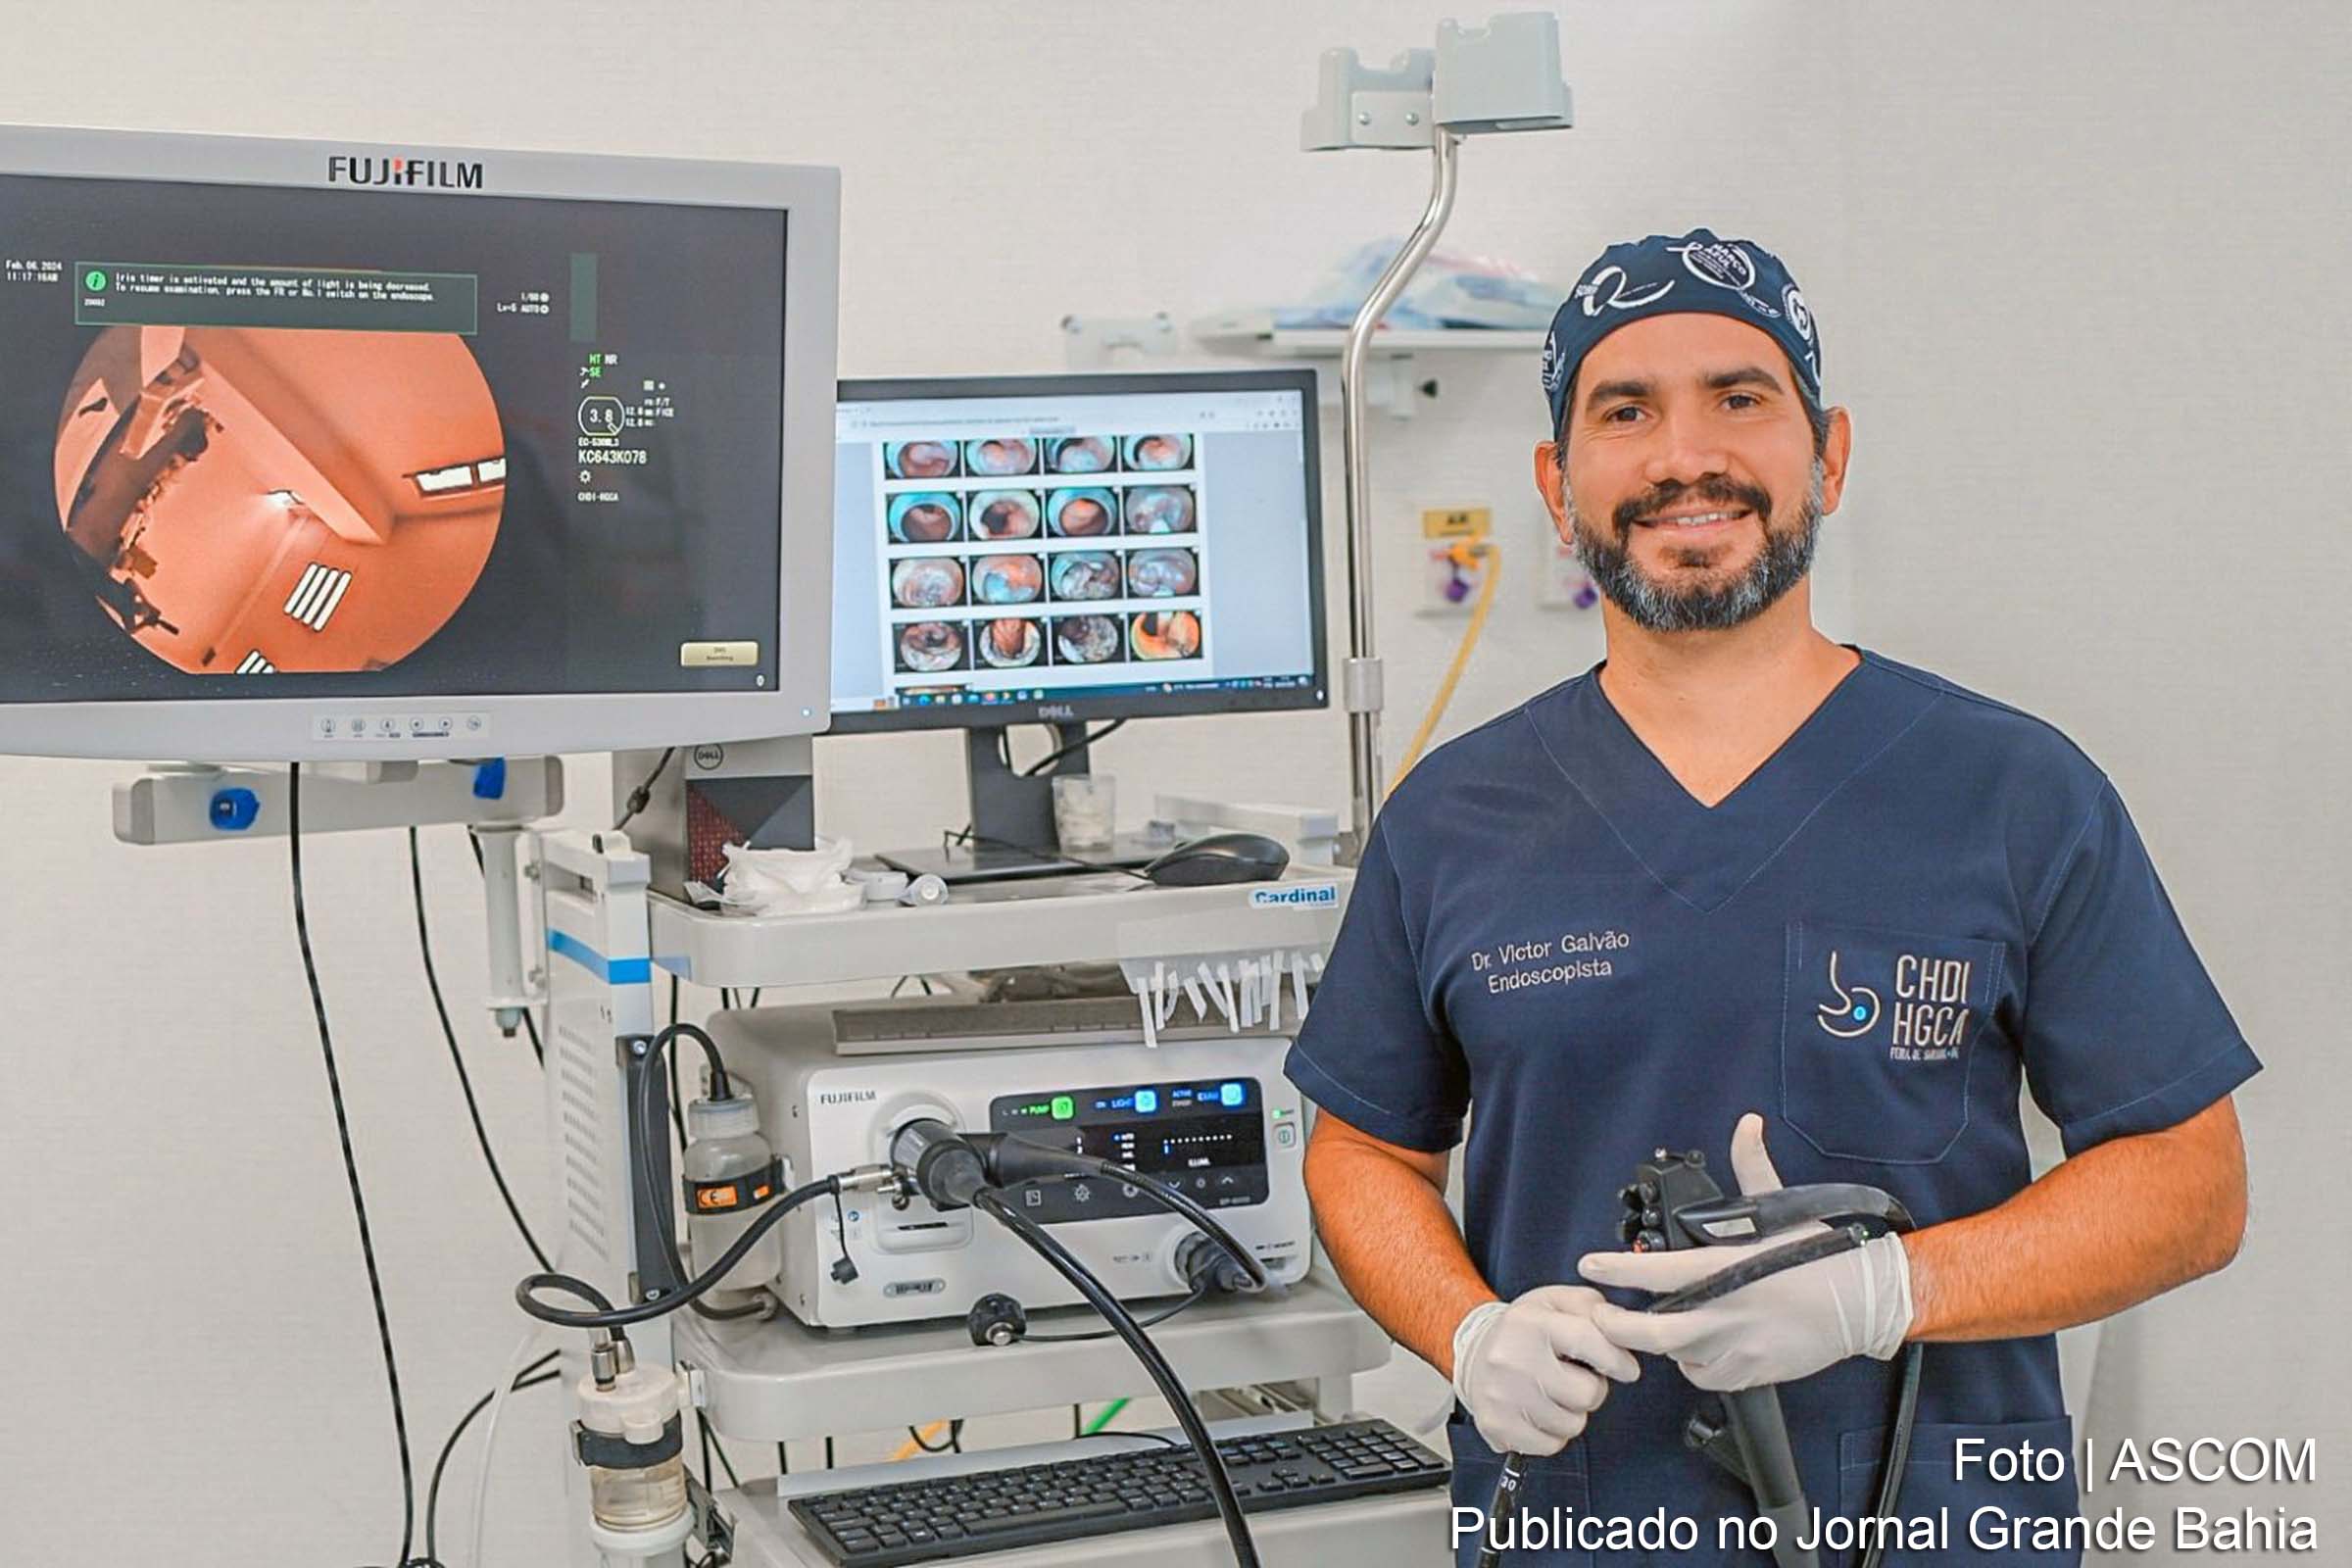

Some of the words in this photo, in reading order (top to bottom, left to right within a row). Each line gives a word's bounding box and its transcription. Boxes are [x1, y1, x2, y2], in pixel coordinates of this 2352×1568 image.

[328, 156, 483, 189] FUJIFILM
[116, 272, 136, 283] Iris
[140, 273, 165, 283] timer
[170, 274, 179, 283] is
[183, 274, 227, 285] activated
[231, 276, 247, 286] and
[251, 276, 266, 286] the
[270, 278, 299, 288] amount
[302, 278, 313, 287] of
[318, 278, 340, 290] light
[345, 279, 355, 289] is
[359, 279, 382, 291] being
[116, 282, 126, 292] To
[130, 284, 161, 293] resume
[226, 286, 252, 296] press
[256, 285, 270, 296] the
[288, 287, 298, 296] or
[325, 289, 355, 299] switch
[372, 290, 387, 300] the
[589, 409, 613, 422] 3.8
[578, 449, 647, 465] KC643K078
[1254, 887, 1336, 904] Cardinal
[1498, 941, 1552, 965] Victor
[1561, 930, 1631, 954] Galvão
[1488, 958, 1613, 994] Endoscopista
[1895, 955, 1970, 1004] CHDI
[1892, 1002, 1969, 1047] HGCA
[819, 1091, 877, 1105] FUJIFILM
